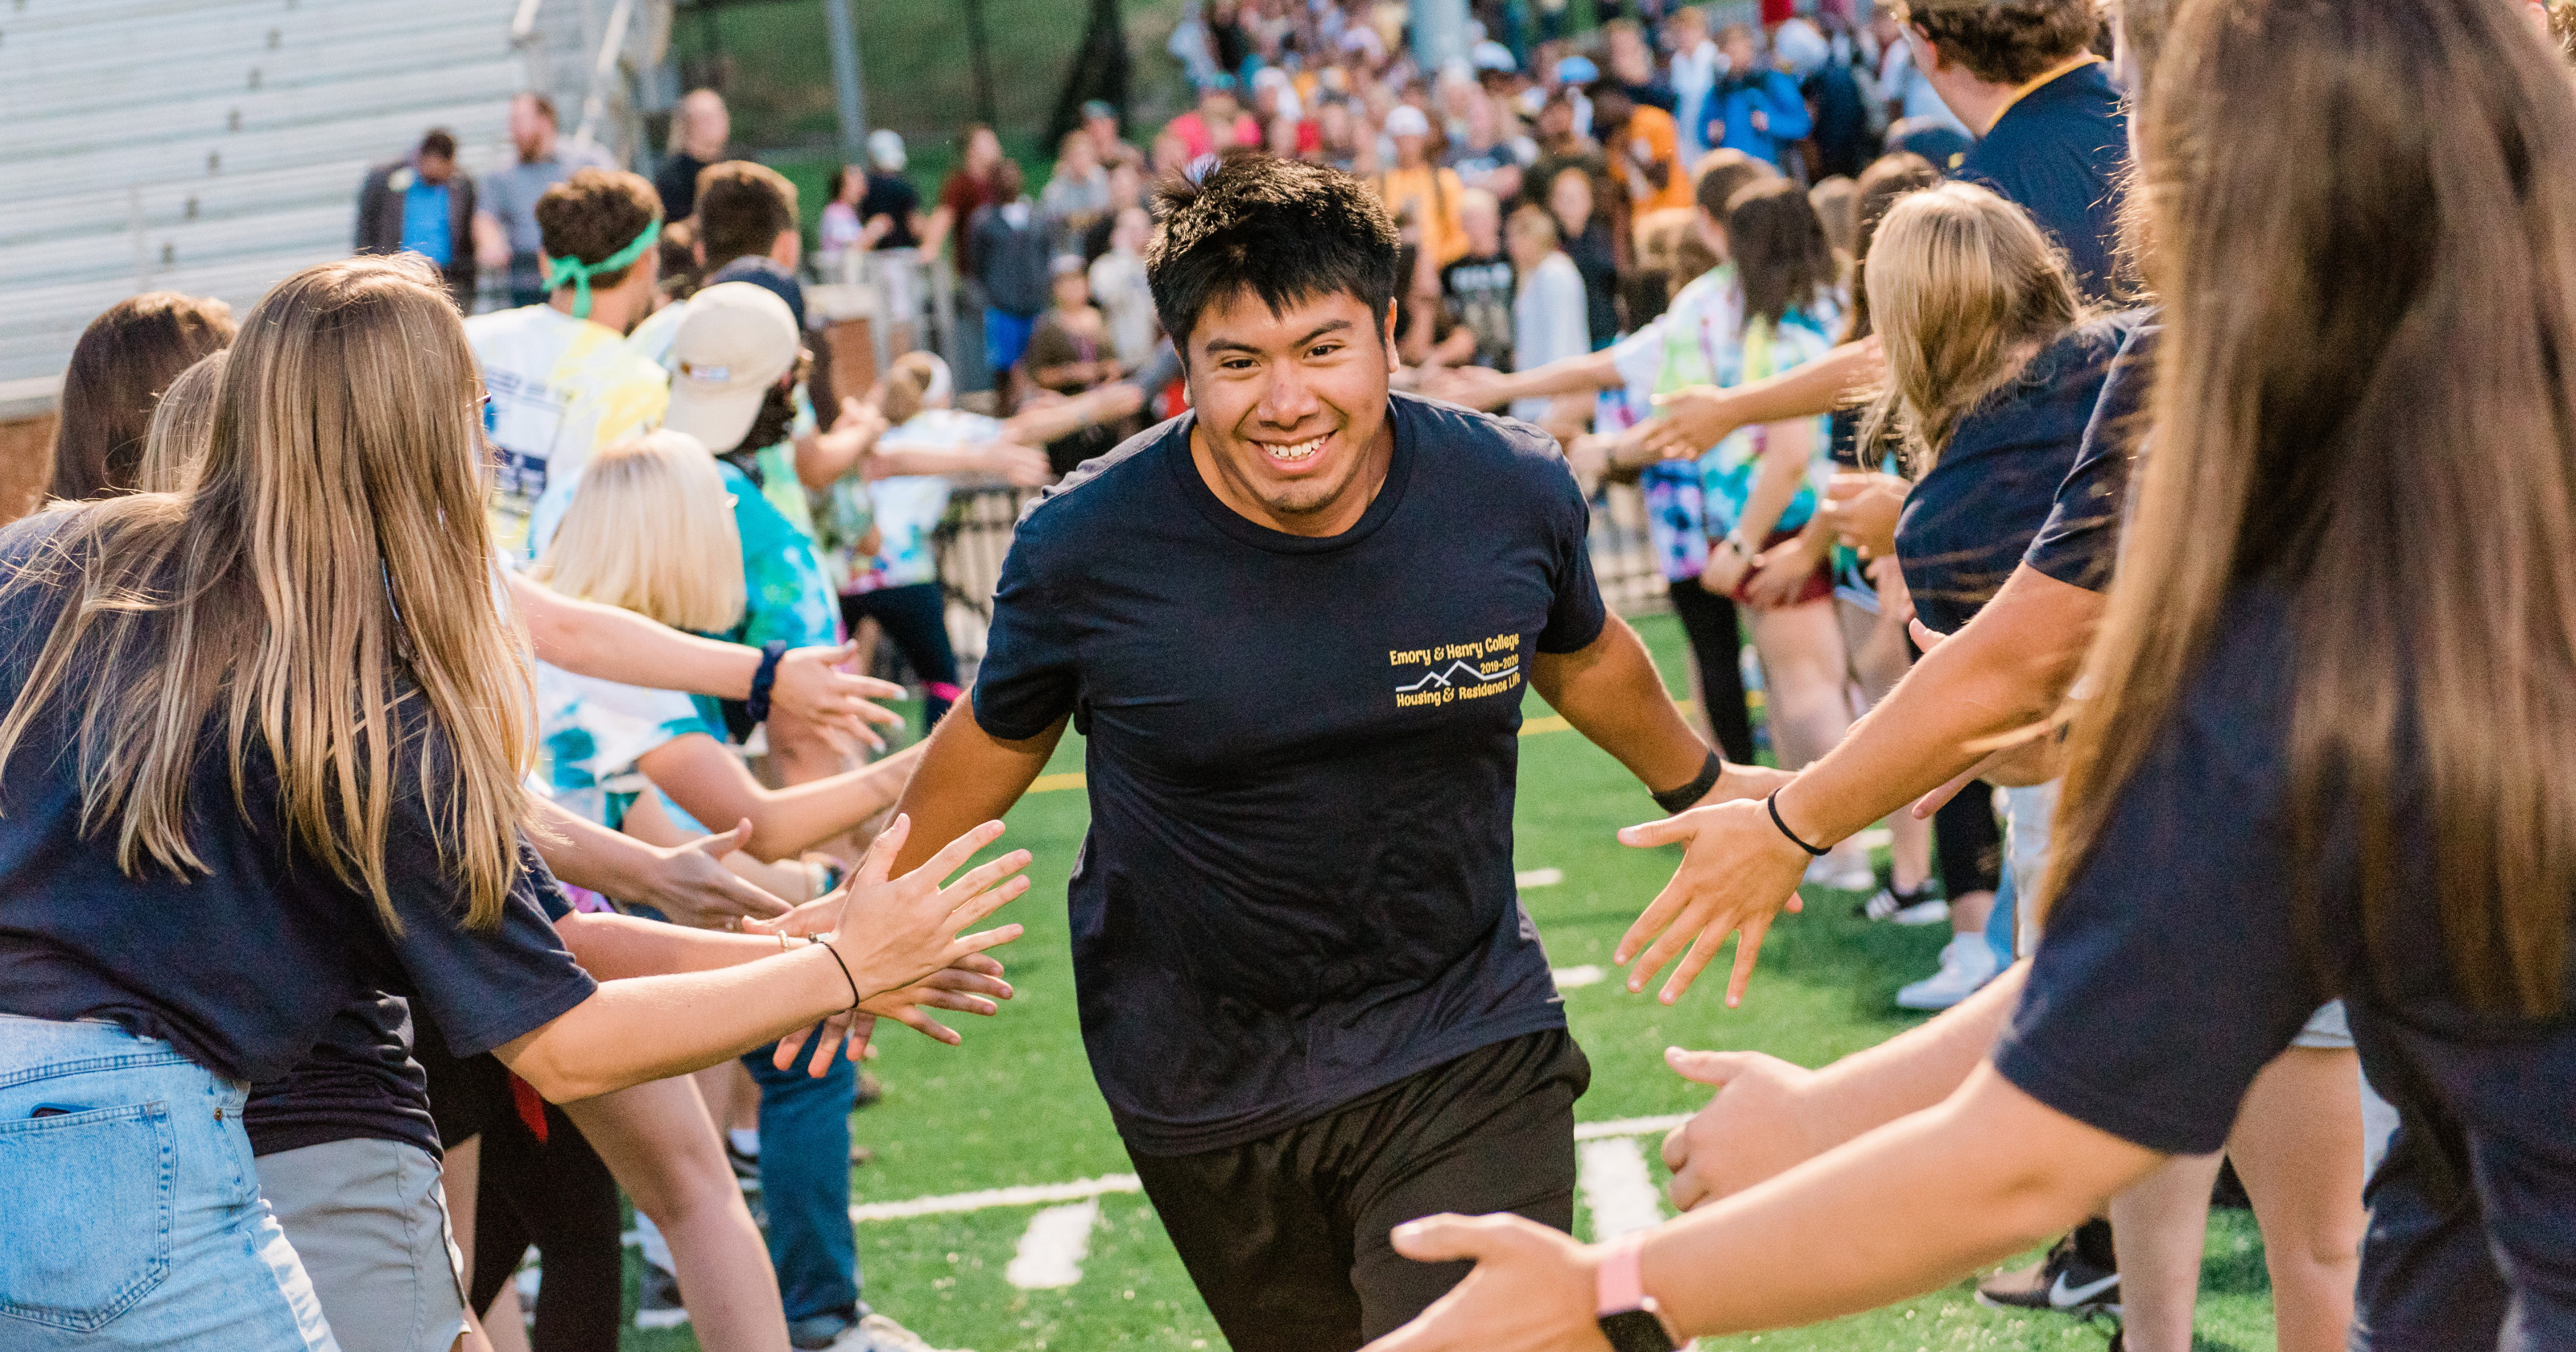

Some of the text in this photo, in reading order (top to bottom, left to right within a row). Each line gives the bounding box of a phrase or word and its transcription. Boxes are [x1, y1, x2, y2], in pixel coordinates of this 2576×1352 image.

[1389, 633, 1520, 666] Emory & Henry College
[1480, 654, 1519, 674] 2019-2020
[1397, 672, 1521, 707] Housing & Residence Life
